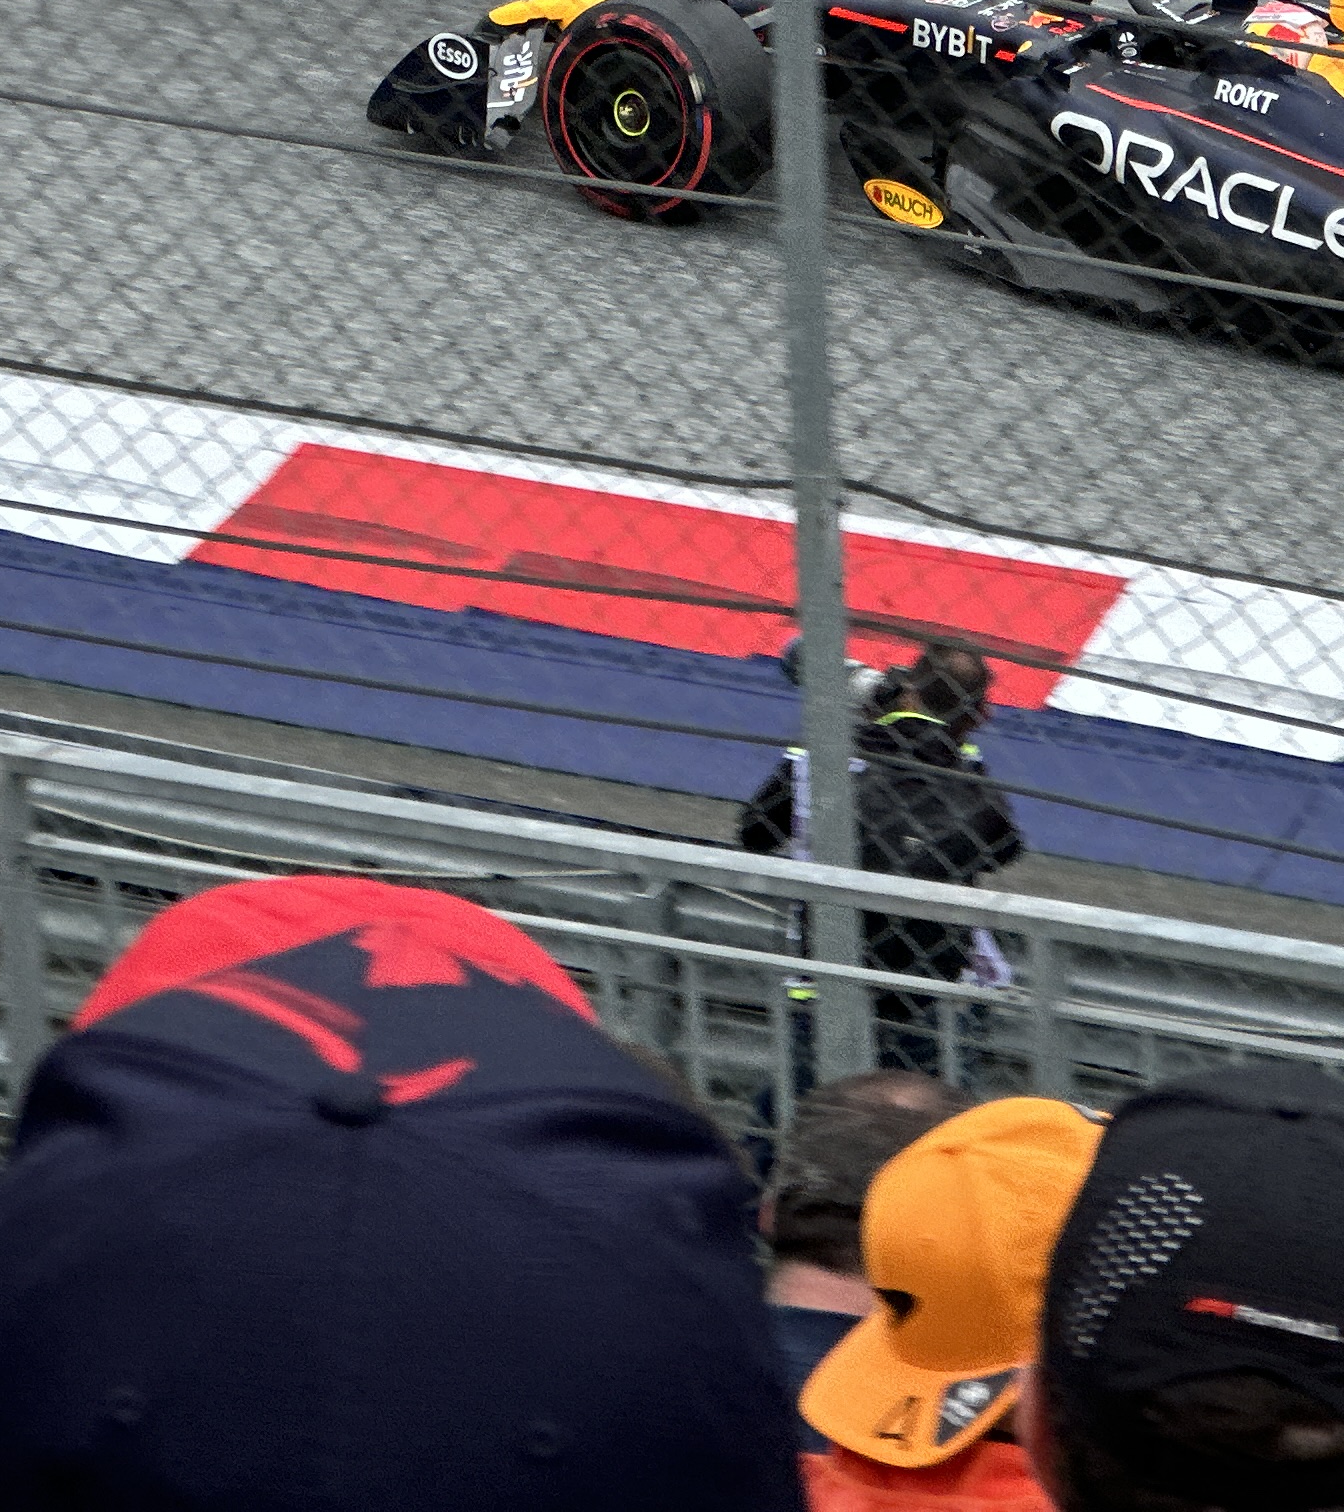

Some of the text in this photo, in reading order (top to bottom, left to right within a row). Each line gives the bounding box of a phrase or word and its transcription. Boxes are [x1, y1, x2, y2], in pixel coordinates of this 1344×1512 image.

[912, 17, 993, 64] BYBIT
[1213, 78, 1279, 115] ROKT
[883, 189, 934, 222] RAUCH
